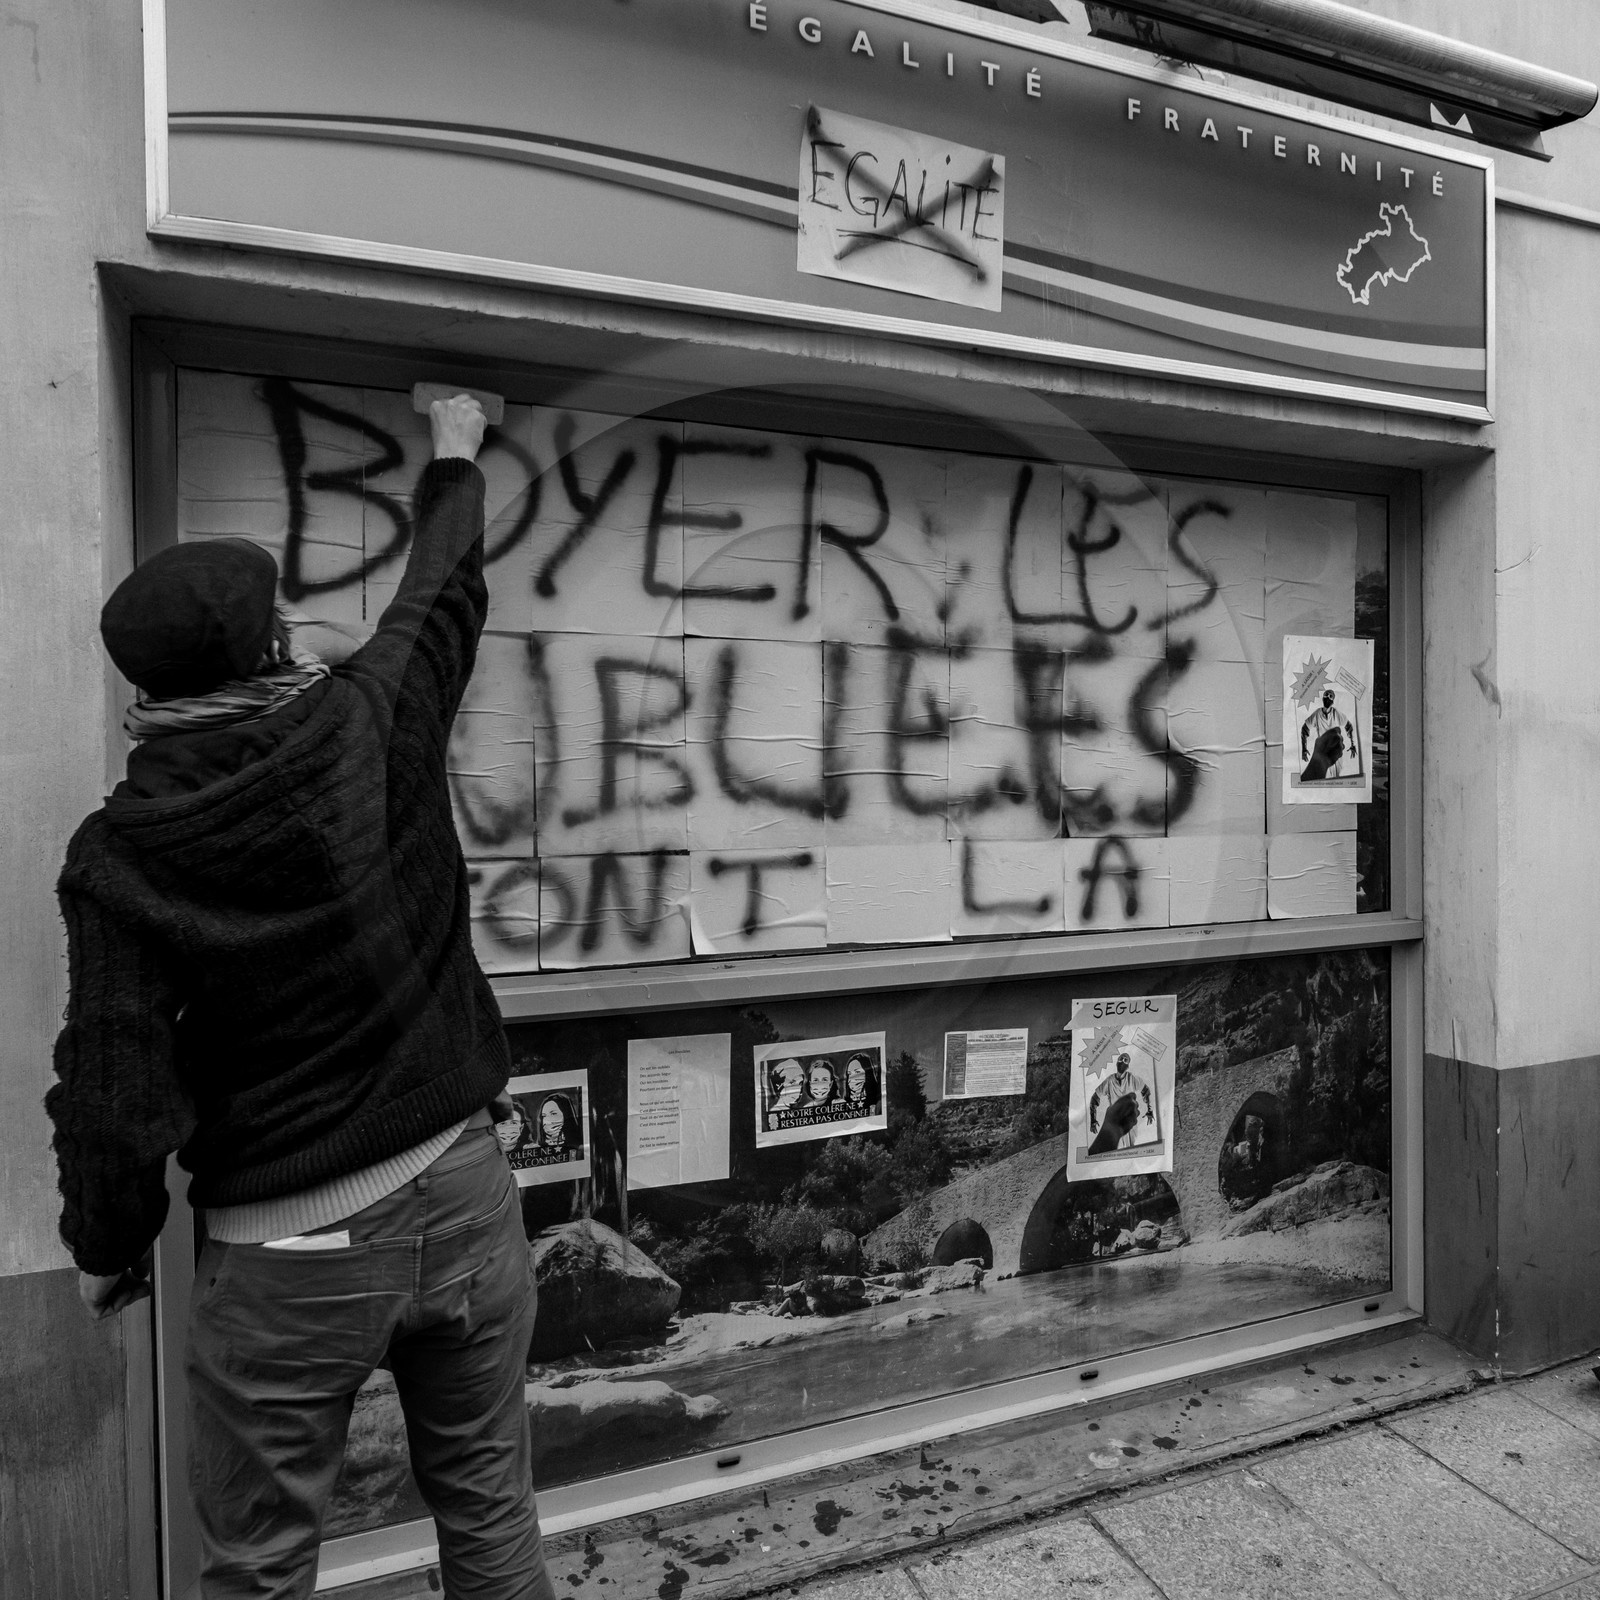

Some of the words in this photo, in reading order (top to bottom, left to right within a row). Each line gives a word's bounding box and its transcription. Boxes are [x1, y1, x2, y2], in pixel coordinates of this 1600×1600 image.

[748, 0, 1042, 98] ÉGALITÉ
[1127, 97, 1444, 197] FRATERNITÉ
[467, 846, 818, 962] ONT
[962, 836, 1142, 924] LA
[1093, 999, 1159, 1019] SEGUR
[786, 1108, 813, 1118] NOTRE
[846, 1101, 856, 1110] NE
[780, 1116, 814, 1128] RESTERA
[816, 1113, 832, 1123] PAS
[506, 1149, 538, 1160] OLERE
[540, 1146, 552, 1155] NE
[510, 1161, 522, 1169] AS
